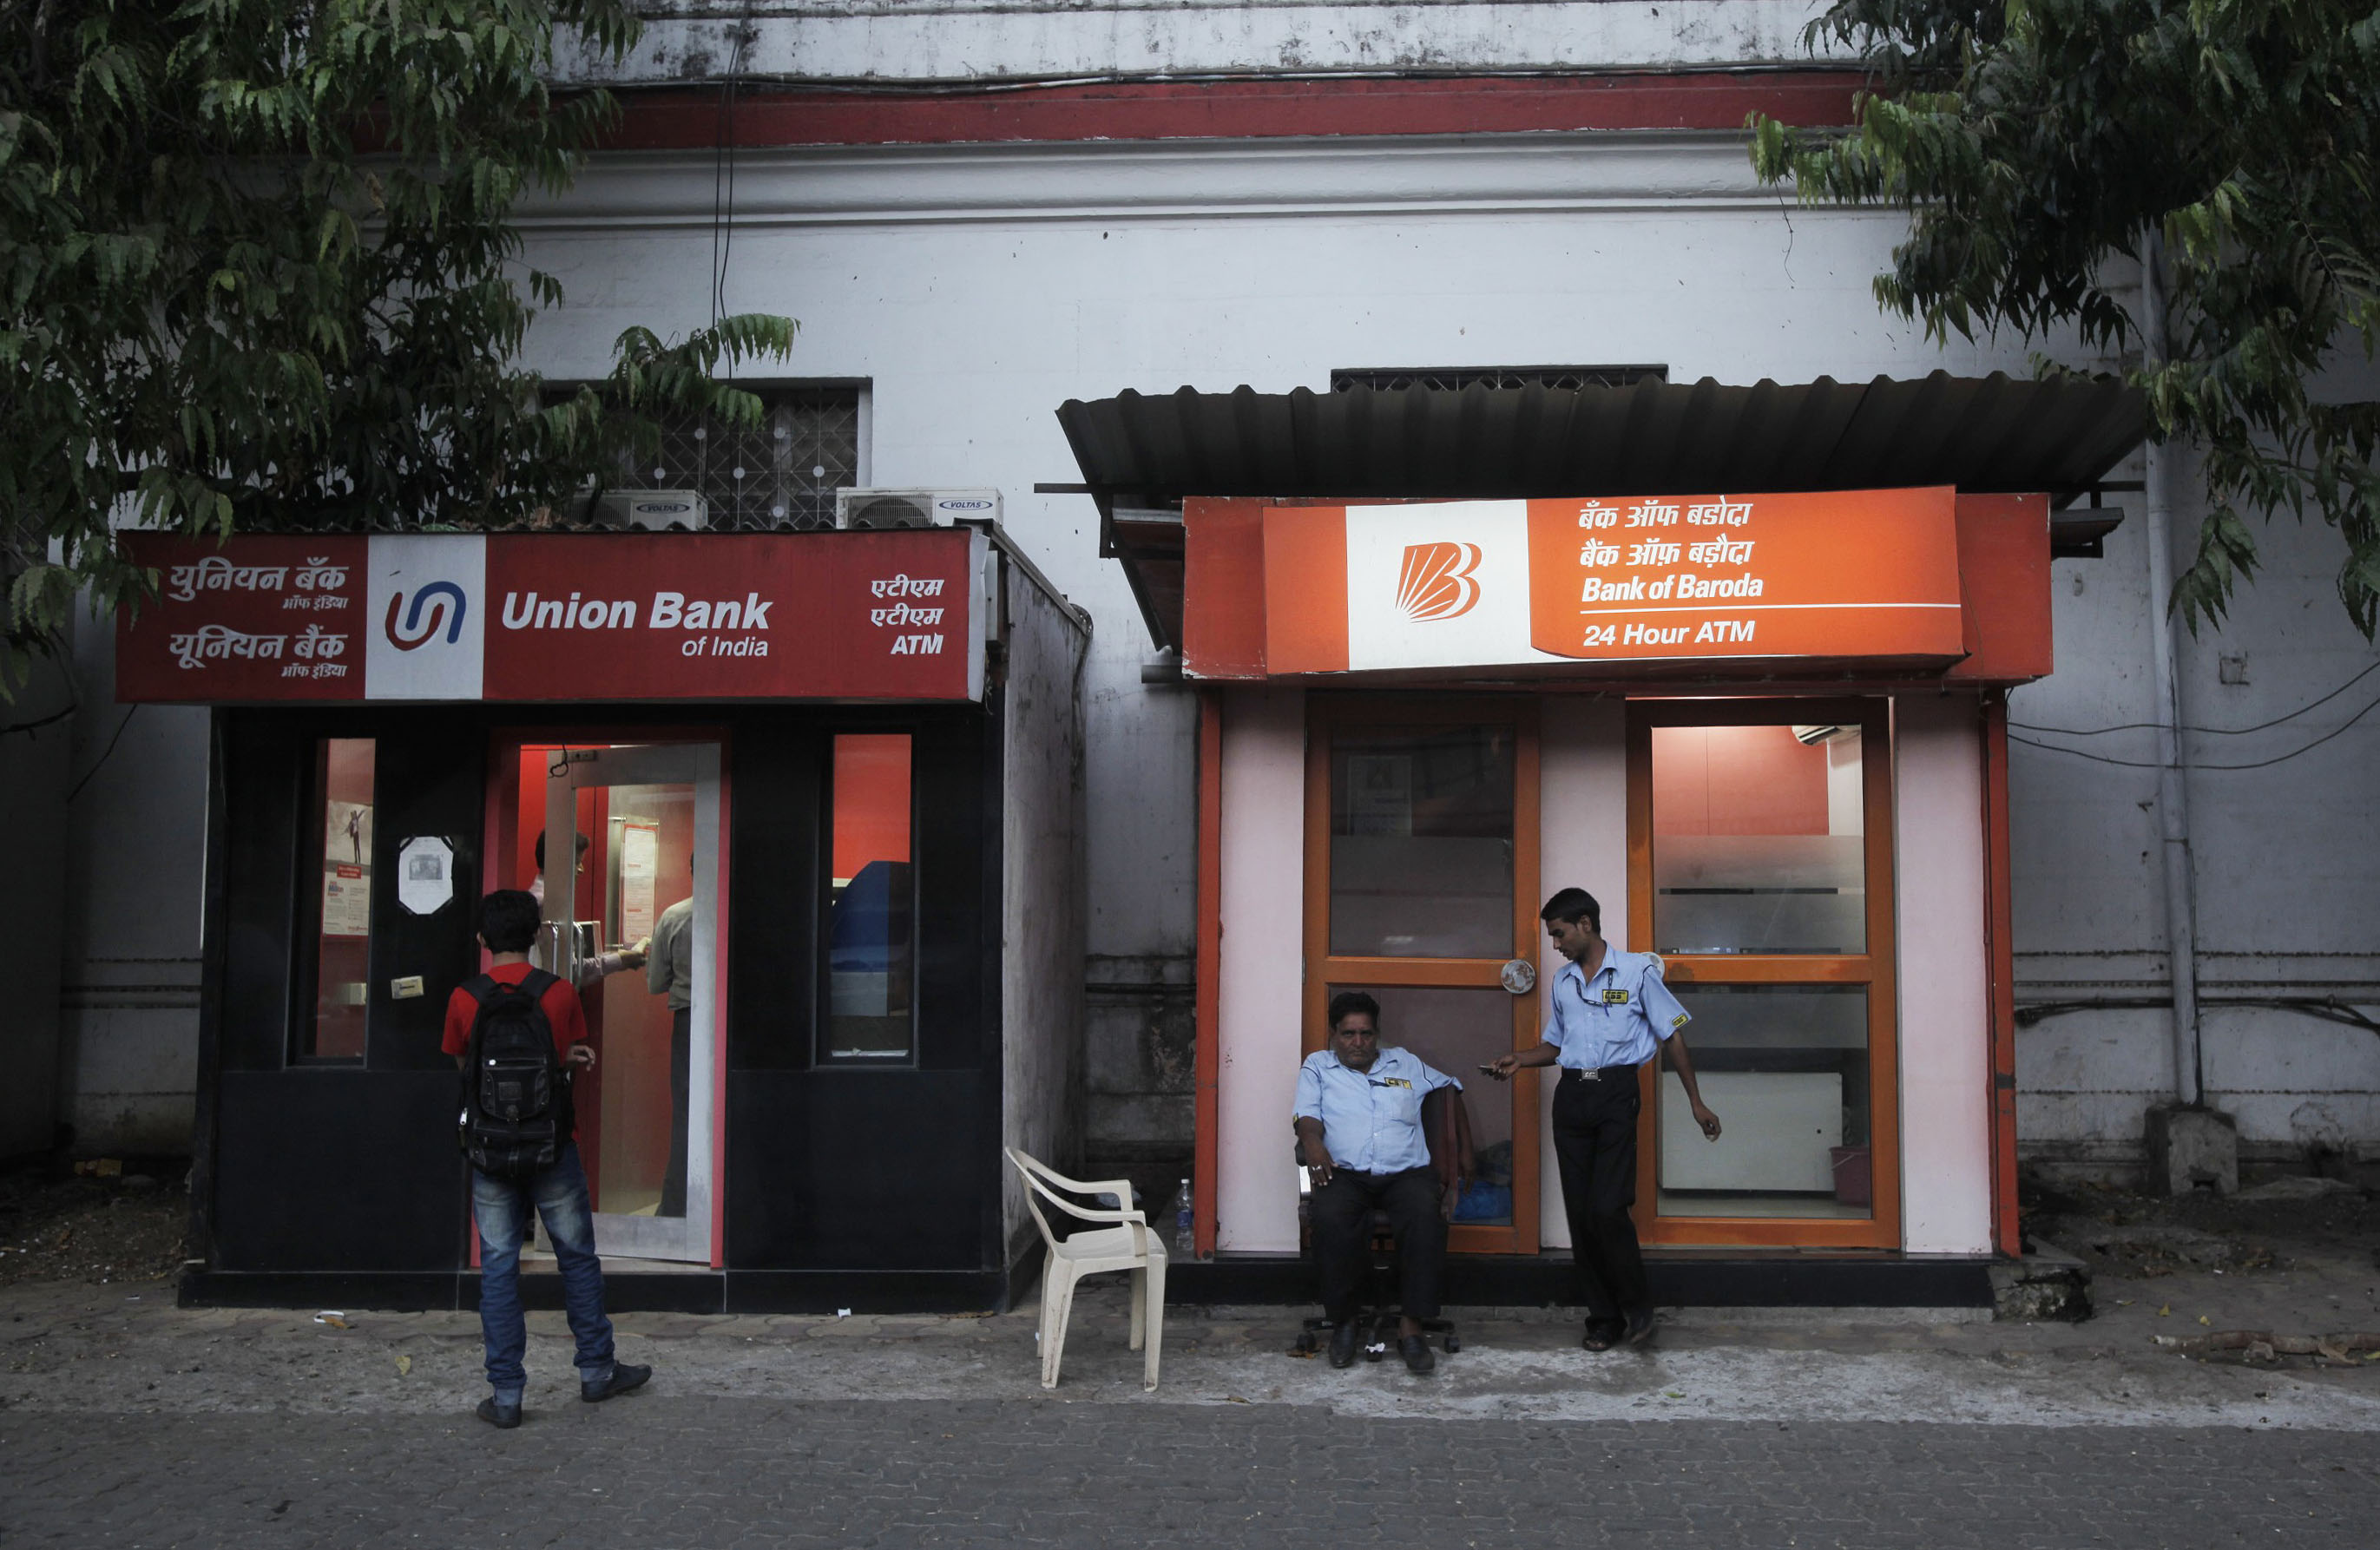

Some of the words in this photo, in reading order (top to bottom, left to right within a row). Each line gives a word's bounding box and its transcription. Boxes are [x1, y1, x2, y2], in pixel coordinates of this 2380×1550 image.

[1625, 500, 1680, 528] ऑफ
[1687, 495, 1753, 528] बडोदा
[1580, 536, 1621, 567] बैंक
[1688, 533, 1755, 568] बड़ौदा
[168, 556, 289, 602] युनियन
[871, 574, 945, 599] एटीएम
[1582, 575, 1645, 602] Bank
[1648, 575, 1676, 600] of
[1677, 573, 1764, 599] Baroda
[502, 592, 637, 629] Union
[649, 592, 773, 629] Bank
[871, 602, 945, 627] एटीएम
[169, 624, 288, 669] यूनियन
[294, 623, 348, 660] बैंक
[682, 636, 707, 657] of
[711, 636, 768, 657] India
[890, 633, 944, 655] ATM
[1583, 625, 1616, 647] 24
[1623, 623, 1690, 645] Hour
[1694, 621, 1756, 644] ATM
[312, 663, 347, 680] इंडिया
